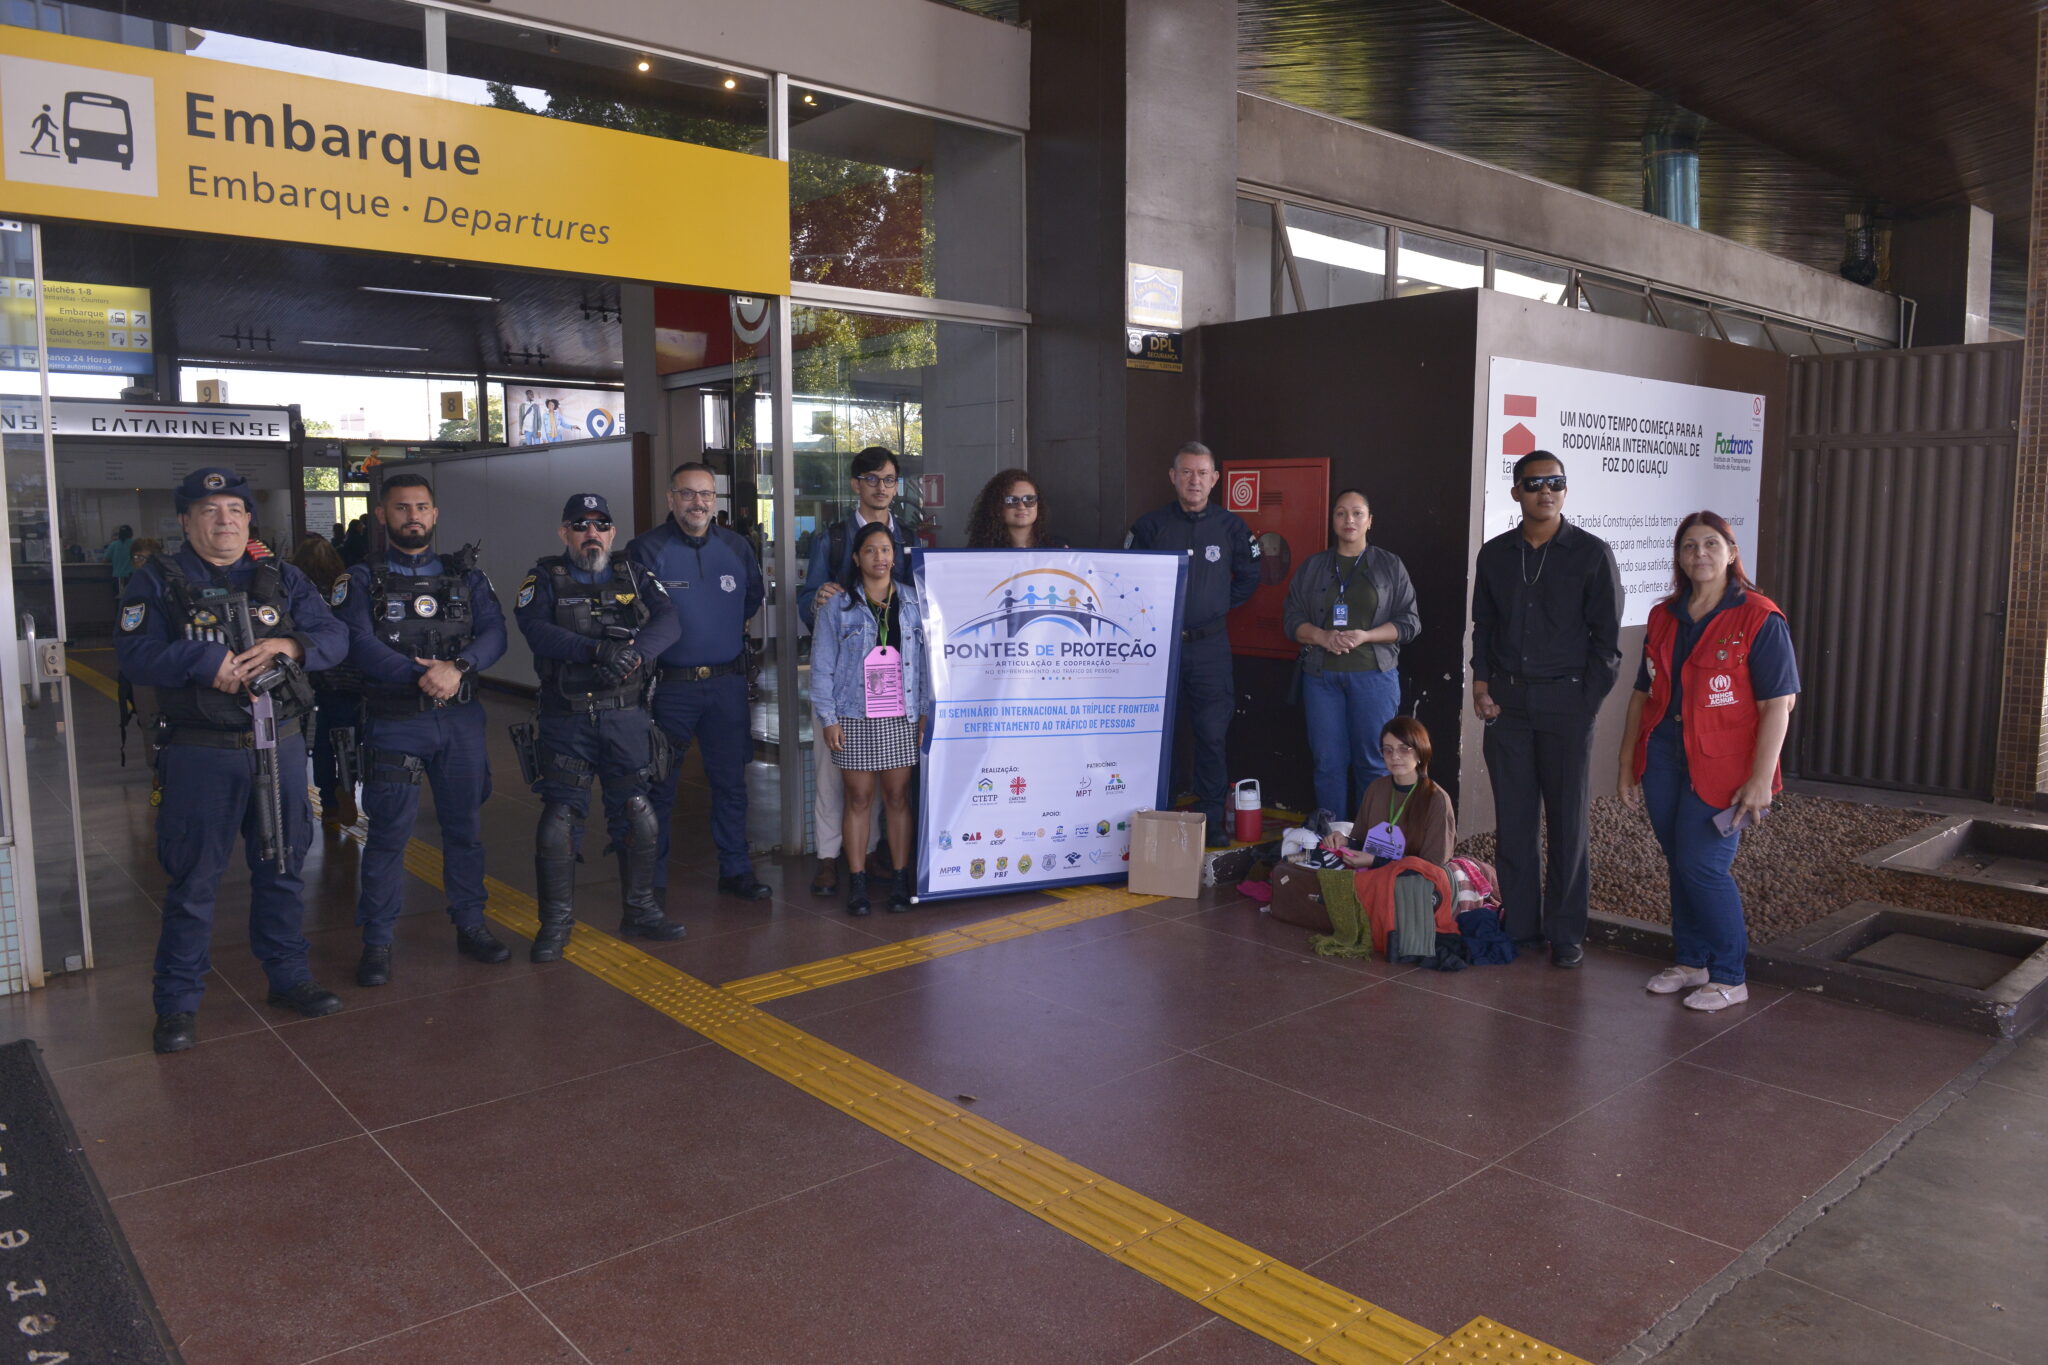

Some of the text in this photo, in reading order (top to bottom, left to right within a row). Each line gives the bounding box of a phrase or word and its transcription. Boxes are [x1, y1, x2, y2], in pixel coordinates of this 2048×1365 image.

[186, 91, 481, 178] Embarque
[188, 165, 611, 246] Embarque Departures
[59, 308, 104, 318] Embarque
[50, 328, 84, 337] Guichês
[1151, 337, 1175, 352] DPL
[87, 356, 111, 364] Horas
[203, 386, 211, 402] 9
[447, 398, 455, 412] 8
[92, 417, 280, 437] CATARINENSE
[1560, 411, 1703, 439] UM NOVO TEMPO COMEÇA PARA A
[1562, 432, 1700, 457] RODOVIÁRIA INTERNACIONAL DE
[1714, 432, 1753, 455] Foztrans
[1602, 457, 1668, 478] FOZ DO IGUAÇU
[1508, 515, 1514, 528] A
[1577, 515, 1601, 528] Tarobá
[1603, 515, 1643, 530] Construções
[1645, 515, 1659, 527] Ltda
[1660, 516, 1673, 527] tem
[1621, 540, 1634, 552] para
[1637, 536, 1664, 549] melhoria
[1635, 562, 1646, 571] sua
[1638, 581, 1663, 593] clientes
[944, 639, 1156, 662] PONTES DE PROTEÇÃO
[1064, 659, 1111, 667] COOPERAÇÃO
[949, 705, 998, 718] SEMINÁRIO
[1002, 706, 1068, 716] INTERNACIONAL
[1071, 705, 1080, 715] DA
[1083, 703, 1115, 714] TRÍPLICE
[1118, 703, 1159, 714] FRONTEIRA
[964, 718, 1135, 732] ENFRENTAMENTO AO TRÁFICO DE PESSOAS
[982, 766, 1019, 774] REALIZAÇÃO:
[940, 866, 960, 874] MPPR
